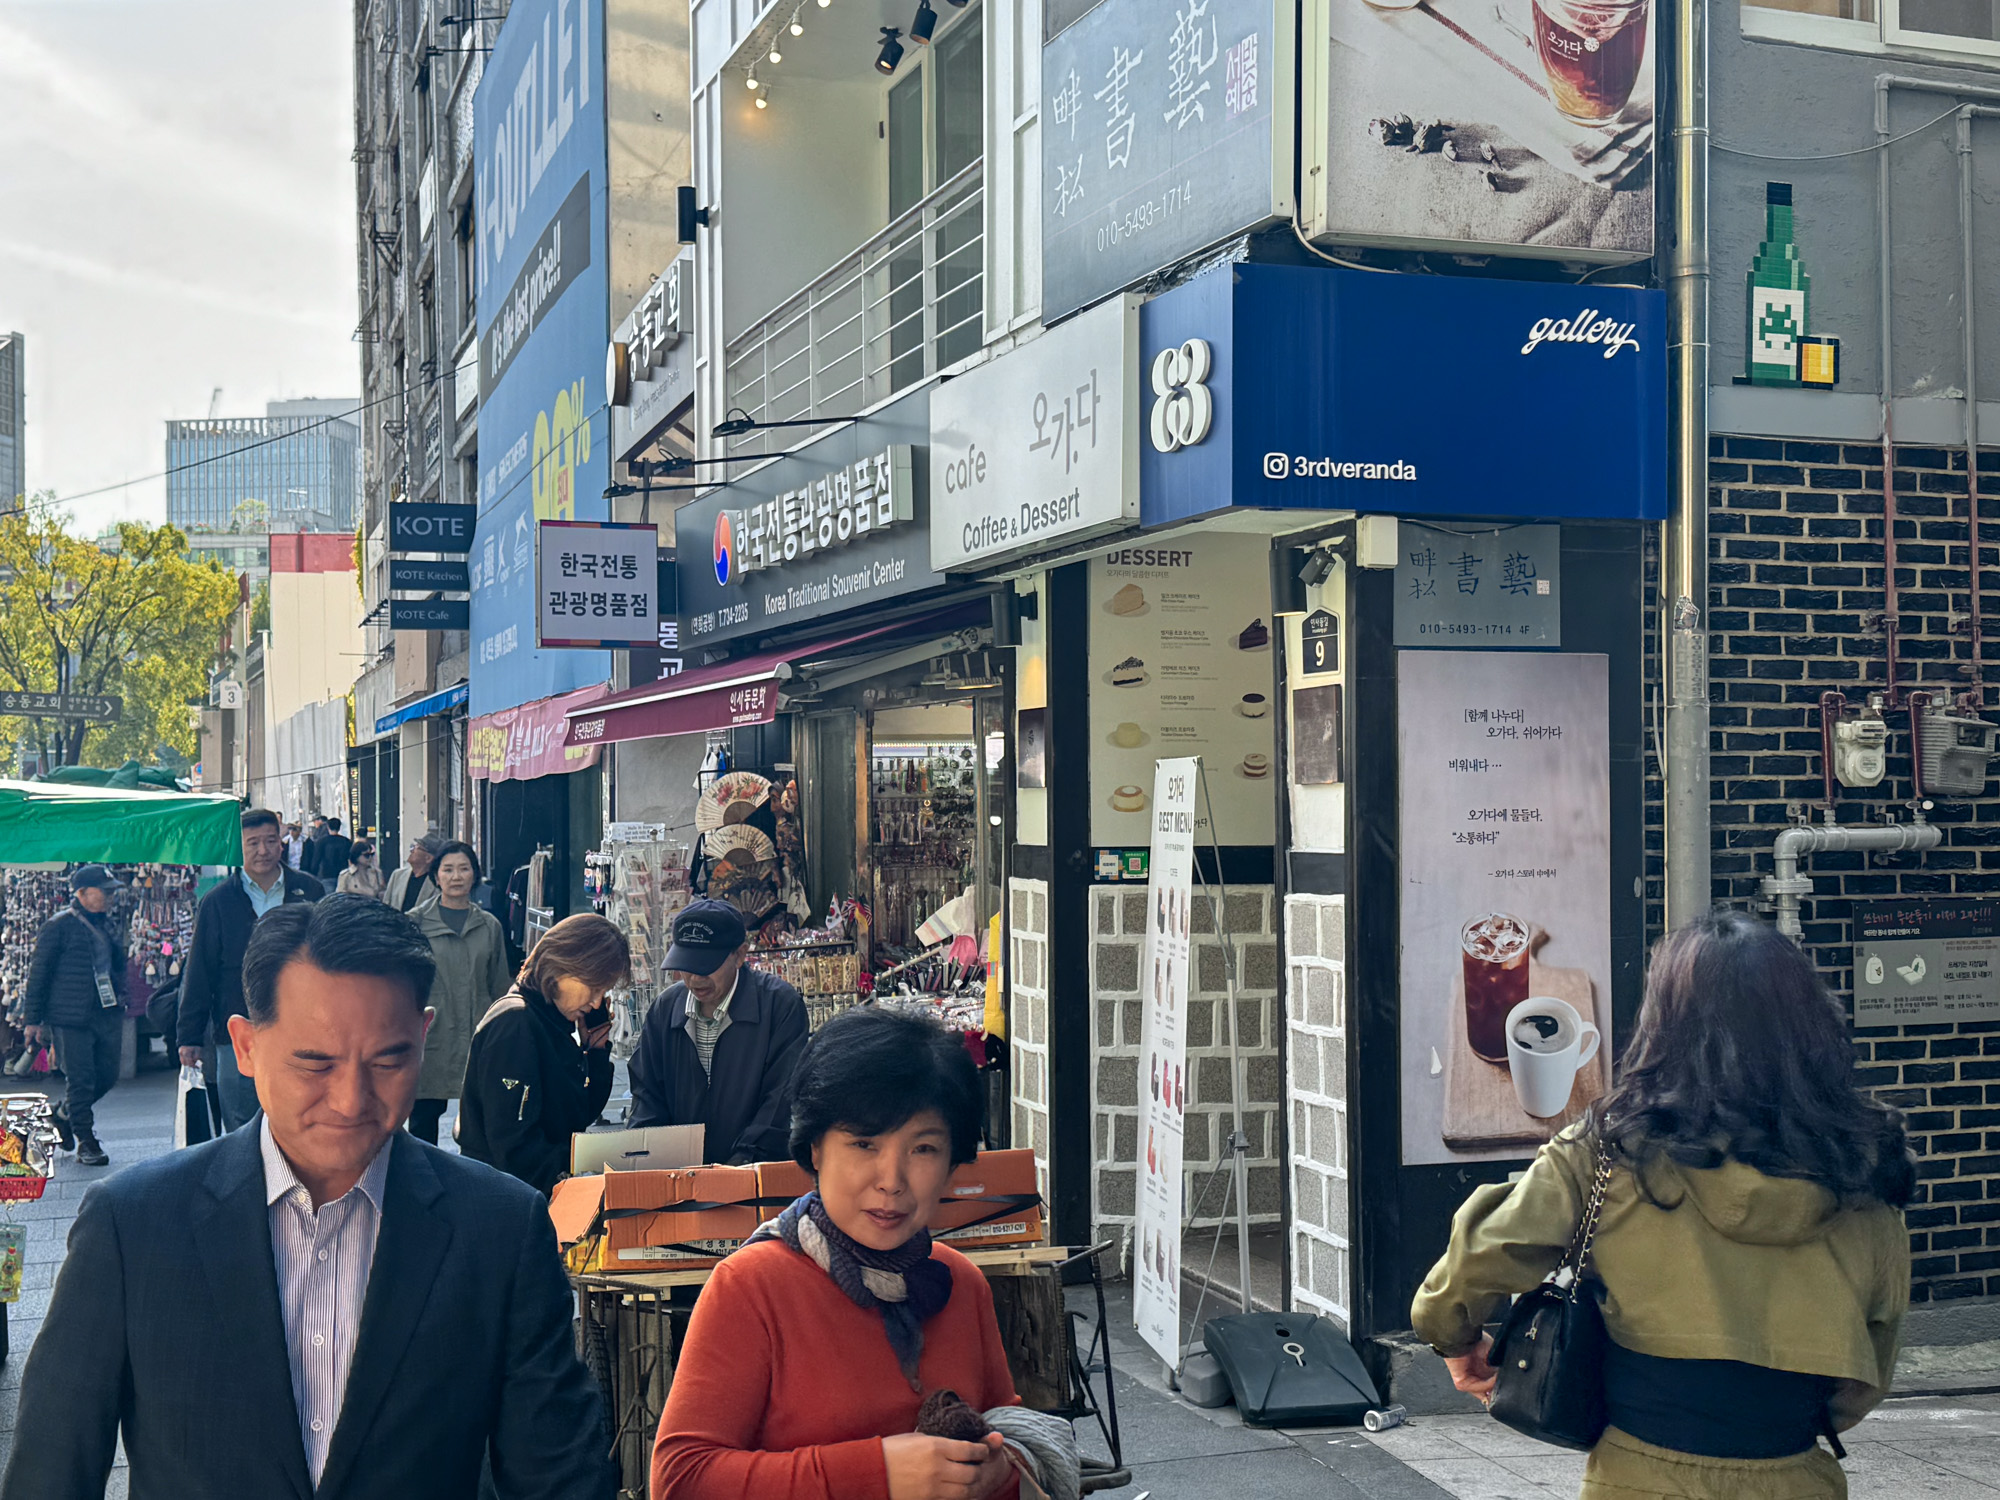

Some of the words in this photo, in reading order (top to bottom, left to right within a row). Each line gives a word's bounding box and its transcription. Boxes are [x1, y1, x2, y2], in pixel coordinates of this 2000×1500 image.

[1097, 180, 1191, 252] 010-5493-1714
[1521, 308, 1640, 360] gallery
[945, 443, 987, 494] cafe
[1294, 457, 1416, 481] 3rdveranda
[737, 445, 893, 574] 한국전통관광명품점
[963, 514, 1008, 553] Coffee
[1010, 518, 1018, 539] &
[1020, 487, 1080, 535] Dessert
[395, 516, 464, 537] KOTE
[560, 552, 638, 580] 한국전통
[1107, 549, 1193, 567] DESSERT
[395, 569, 426, 581] KOTE
[427, 569, 463, 582] Kitchen
[764, 591, 787, 616] Korea
[787, 577, 830, 610] Traditional
[832, 565, 870, 598] Souvenir
[872, 558, 905, 585] Center
[395, 609, 426, 621] KOTE
[427, 609, 450, 621] Cafe
[549, 590, 648, 617] 관광명품점
[1420, 623, 1512, 635] 010-5493-1714
[1519, 624, 1530, 635] 4F
[1315, 640, 1325, 667] 9
[228, 691, 235, 704] 3
[1464, 709, 1488, 723] [함께
[1491, 709, 1524, 723] 나누다]
[1523, 726, 1562, 740] 쉬어가다
[1449, 759, 1489, 772] 비워내다
[1158, 811, 1174, 832] BEST
[1174, 812, 1193, 834] MENU
[1467, 808, 1507, 822] 오가다에
